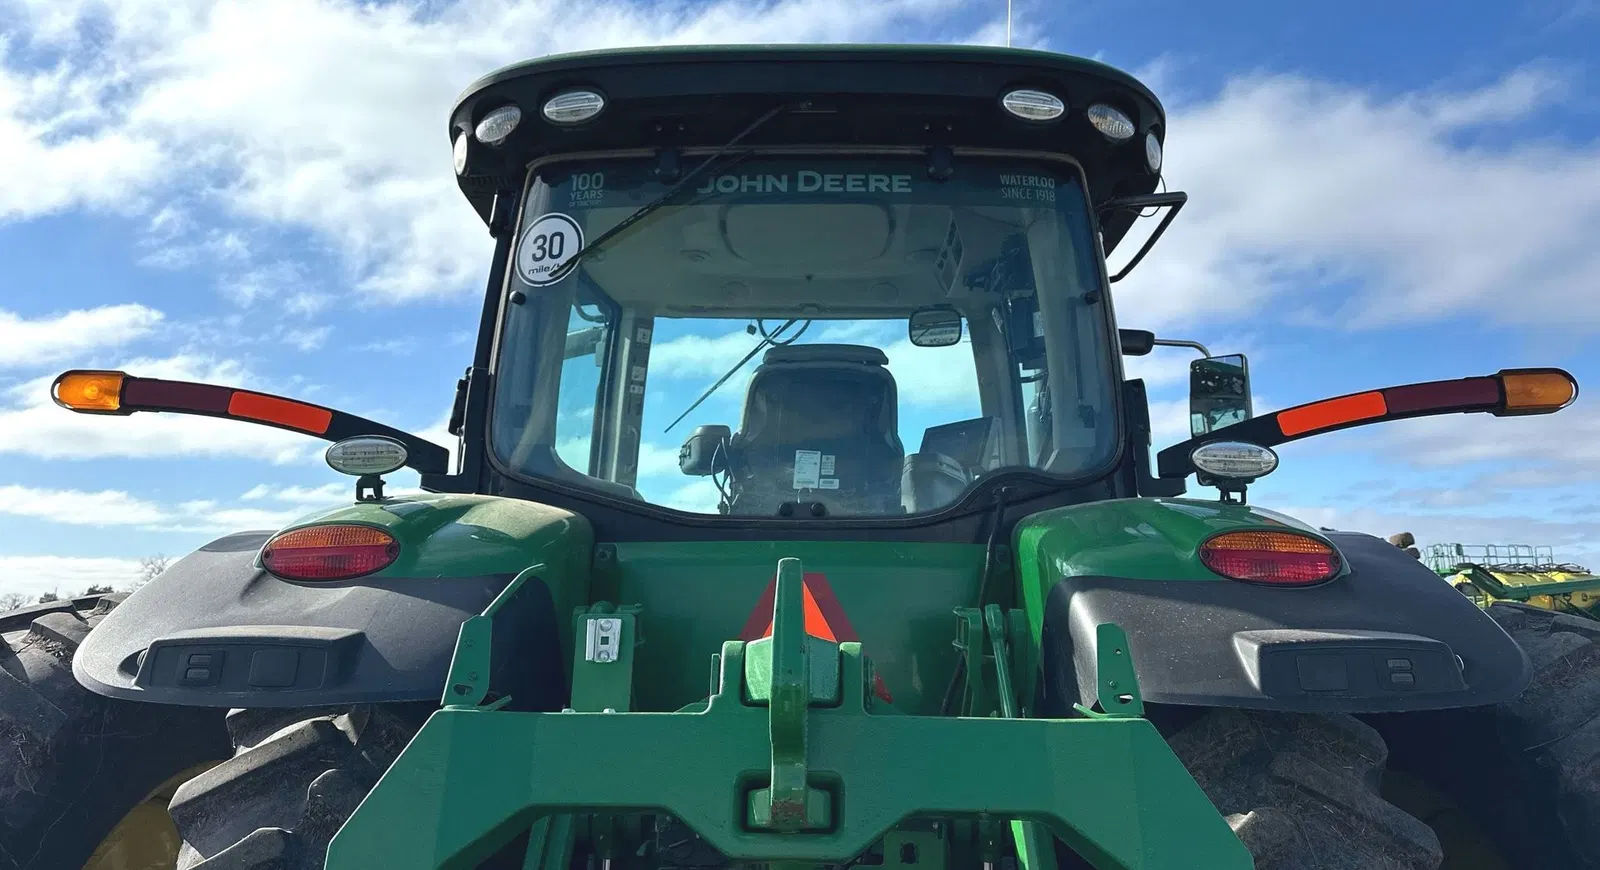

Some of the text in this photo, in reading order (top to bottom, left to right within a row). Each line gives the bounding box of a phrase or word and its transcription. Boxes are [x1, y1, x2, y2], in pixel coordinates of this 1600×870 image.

[571, 172, 604, 191] 100
[697, 170, 912, 194] JOHN DEERE
[1000, 174, 1056, 189] WATERLOO
[570, 190, 603, 201] YEARS
[1001, 187, 1056, 202] SINCE 1918
[532, 231, 565, 262] 30
